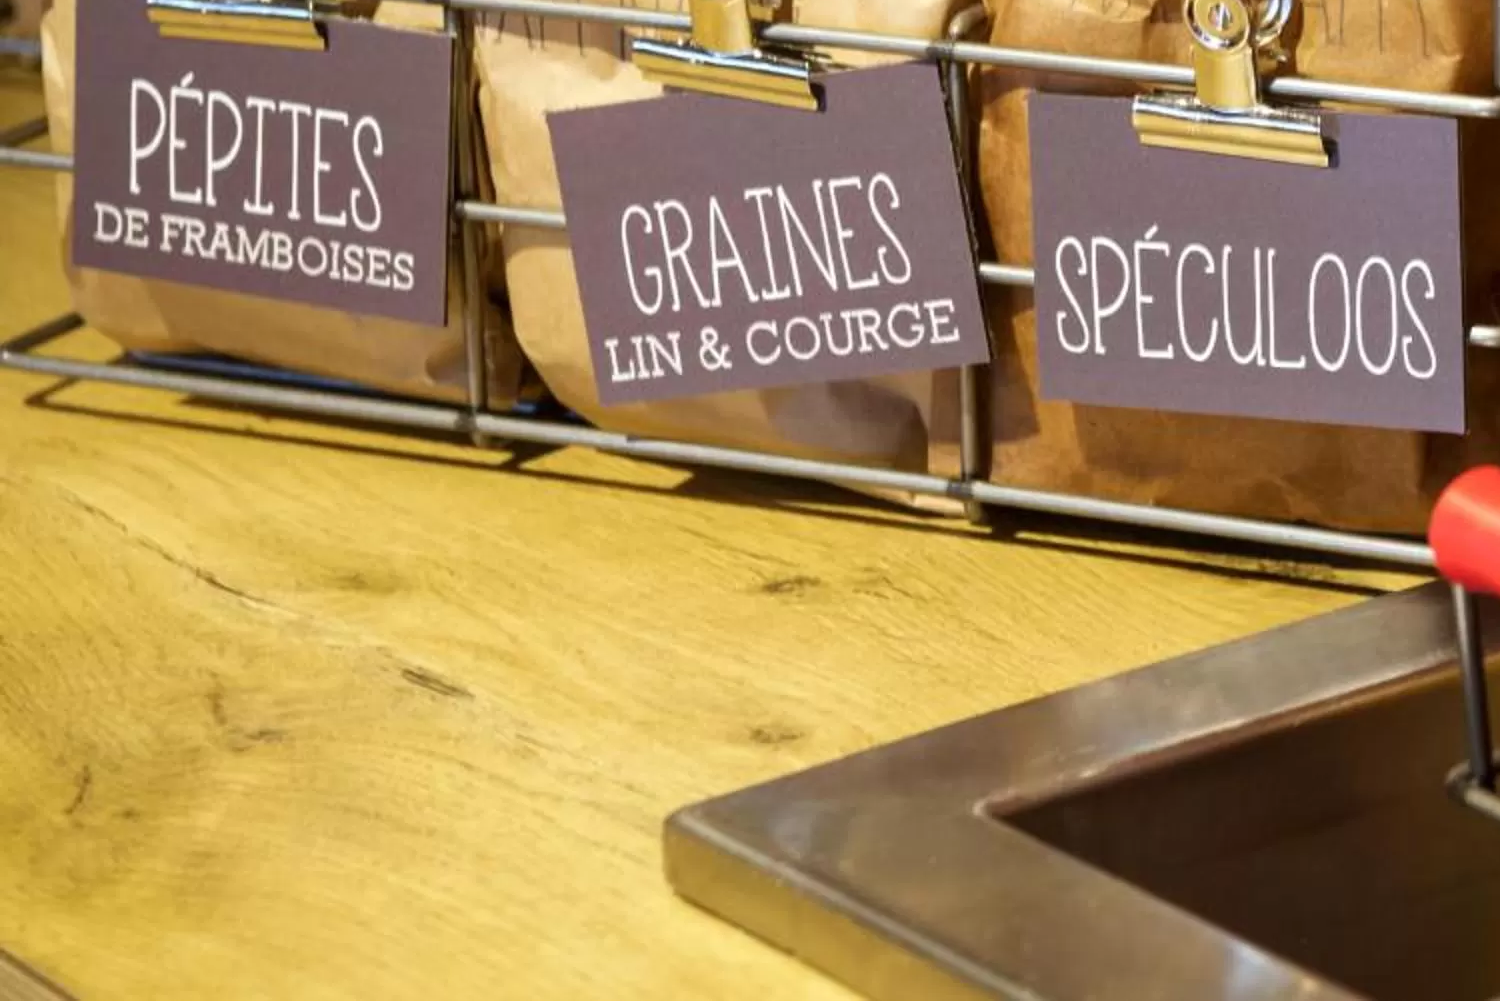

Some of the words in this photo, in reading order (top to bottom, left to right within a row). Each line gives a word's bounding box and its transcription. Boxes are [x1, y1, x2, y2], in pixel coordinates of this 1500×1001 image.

[128, 71, 384, 232] PÉPITES
[93, 202, 150, 248] DE
[159, 213, 415, 292] FRAMBOISES
[620, 171, 912, 316] GRAINES
[1054, 222, 1438, 380] SPÉCULOOS
[604, 330, 684, 384] LIN
[698, 326, 734, 372] &
[745, 298, 961, 366] COURGE
